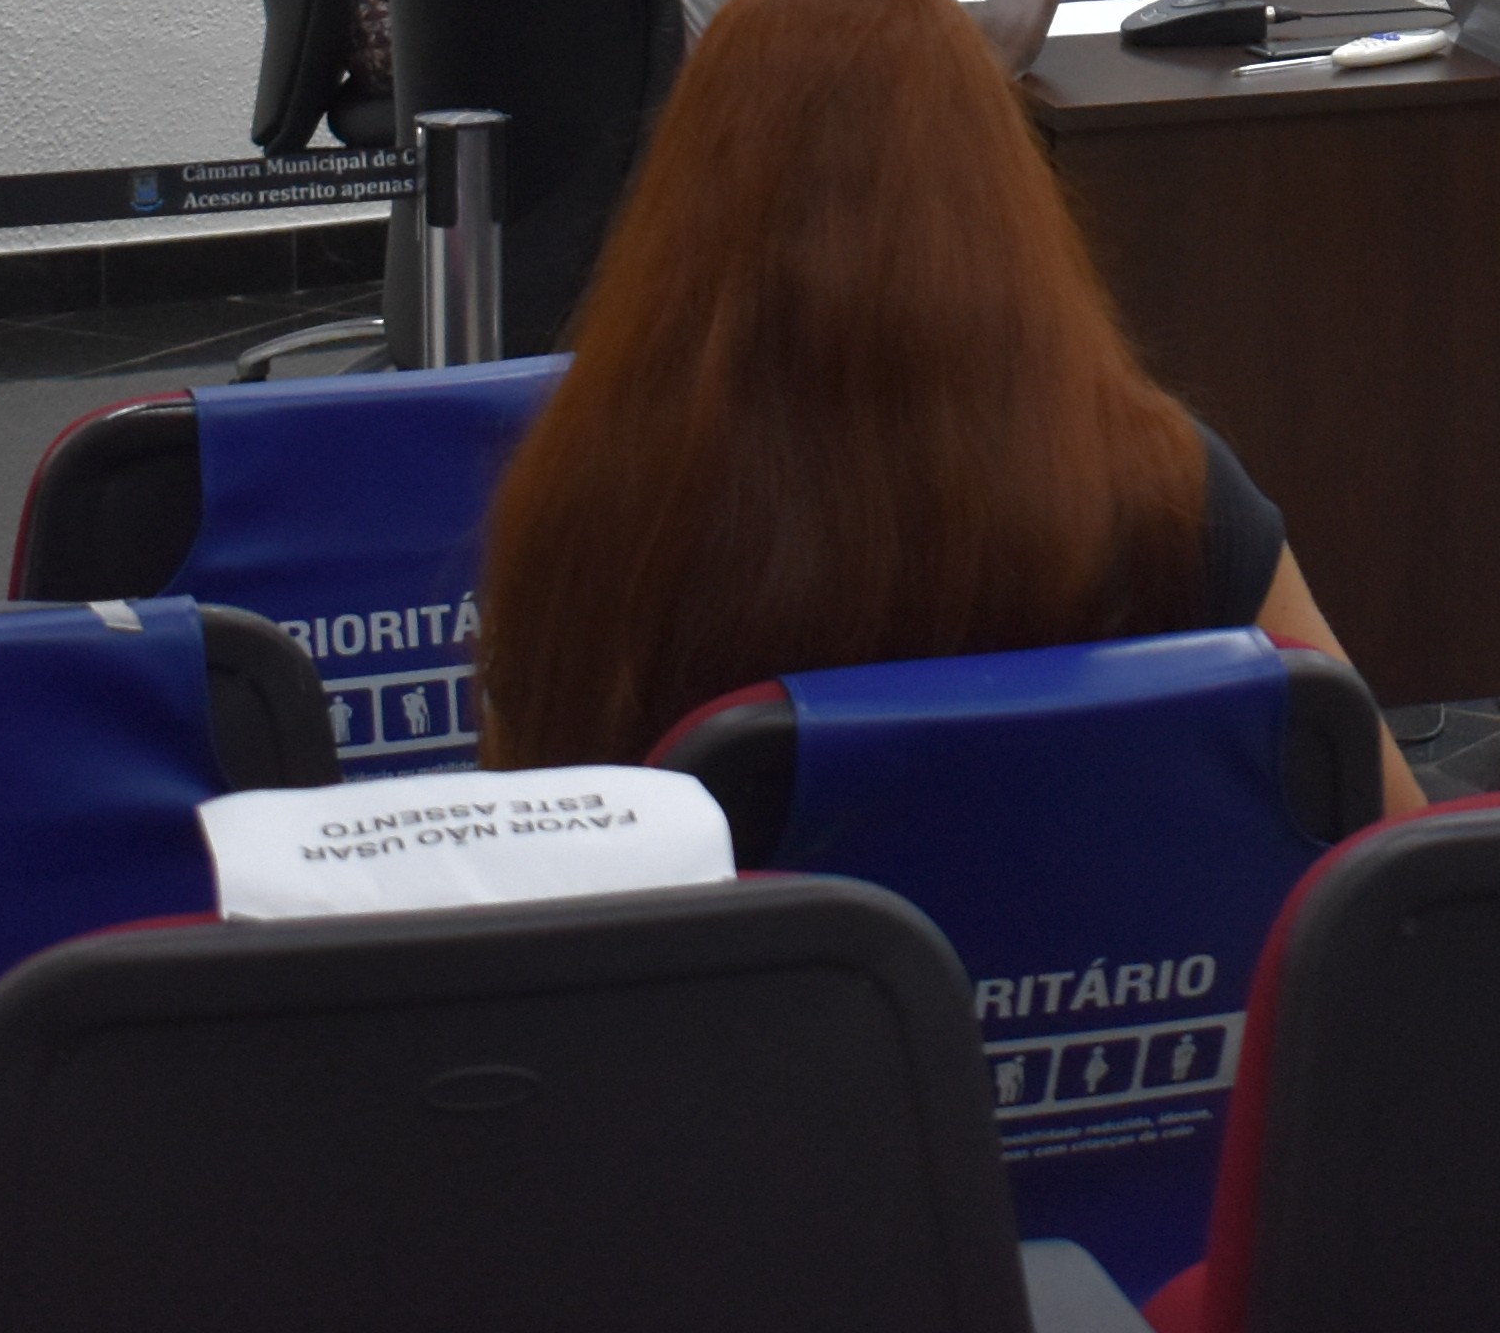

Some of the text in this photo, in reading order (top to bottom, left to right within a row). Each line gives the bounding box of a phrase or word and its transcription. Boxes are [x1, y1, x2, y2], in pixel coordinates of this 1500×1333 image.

[182, 162, 260, 182] Câmara
[266, 151, 367, 176] Municipal
[373, 150, 396, 167] de
[183, 178, 414, 209] Acesso restrito apenas
[321, 793, 605, 838] ESTE ASSENTO
[302, 809, 638, 861] FAVOR NÃO USAR
